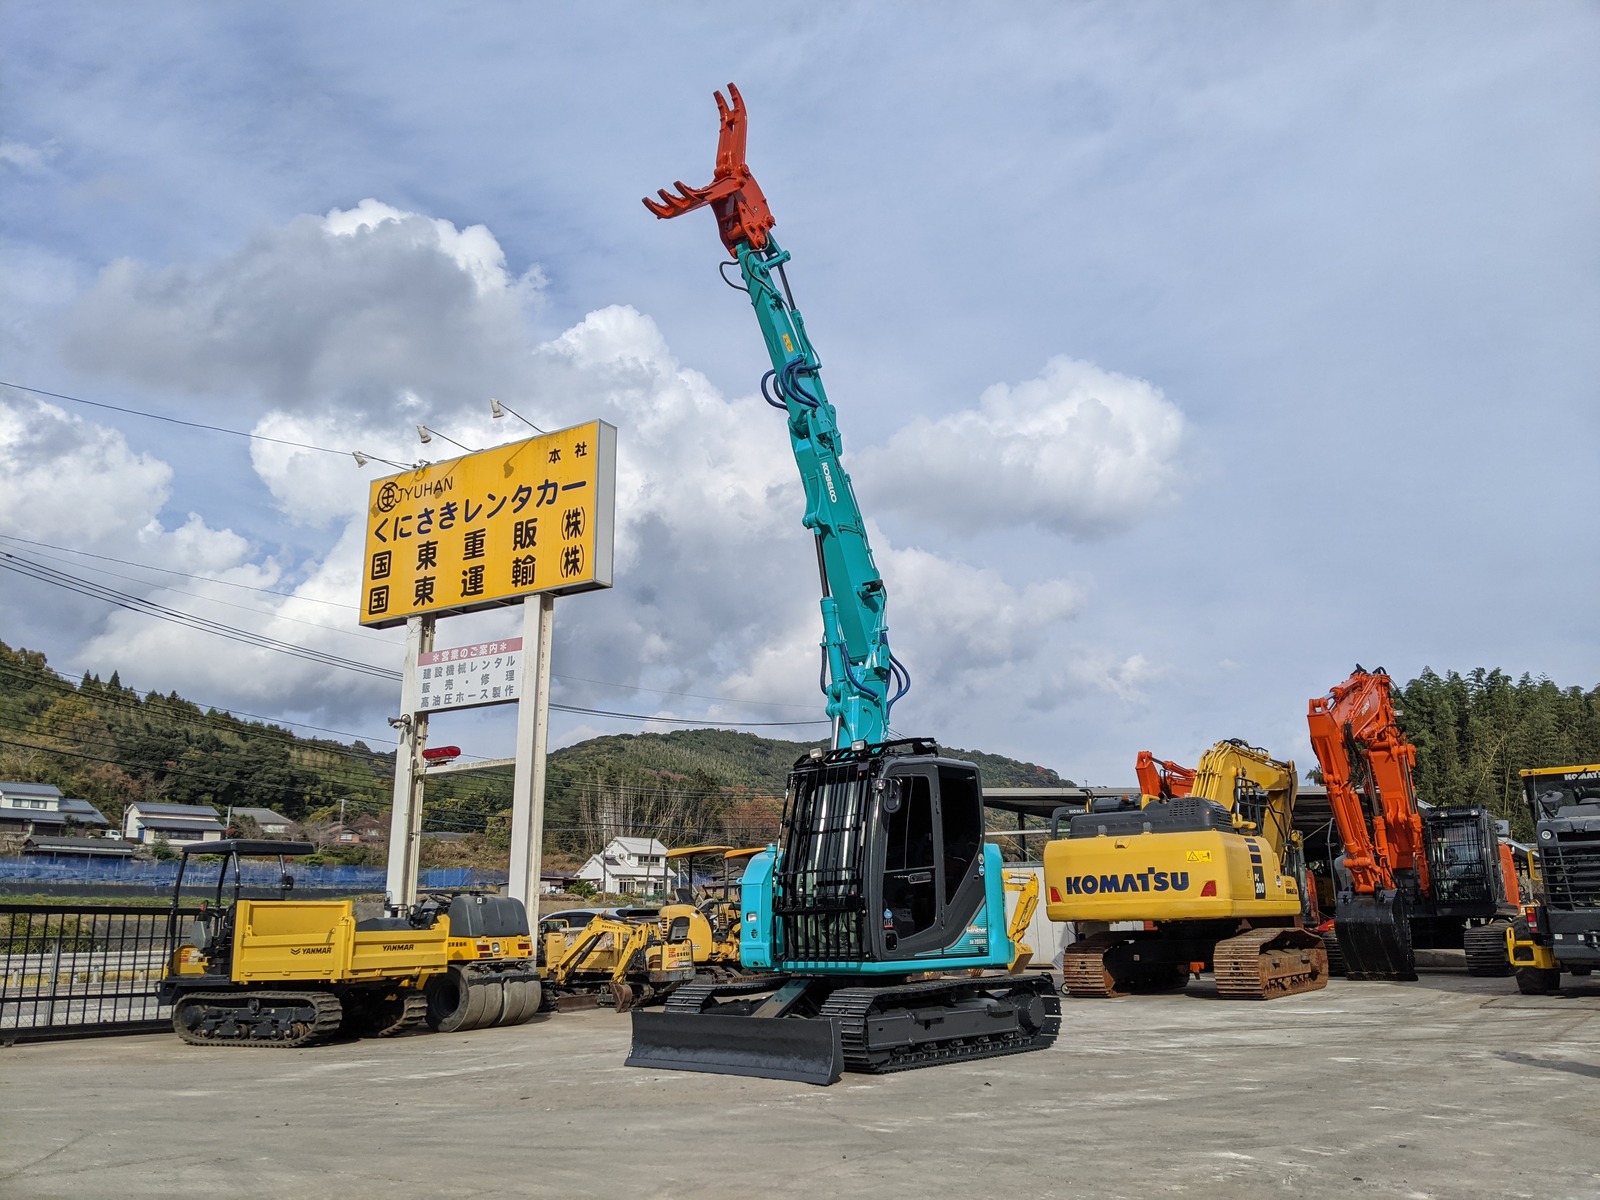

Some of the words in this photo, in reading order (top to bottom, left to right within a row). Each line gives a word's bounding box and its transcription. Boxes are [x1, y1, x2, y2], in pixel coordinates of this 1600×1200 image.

[548, 441, 587, 464] 本社
[821, 462, 837, 503] KOBELCO
[374, 478, 587, 542] くにさきレンタカー
[422, 655, 516, 680] 建設機械レンタル
[420, 685, 514, 709] 高油圧ホース製作
[1066, 867, 1190, 895] KOMATSU
[1255, 882, 1265, 894] 200
[302, 947, 332, 955] YANMAR
[382, 944, 414, 952] YANMAR
